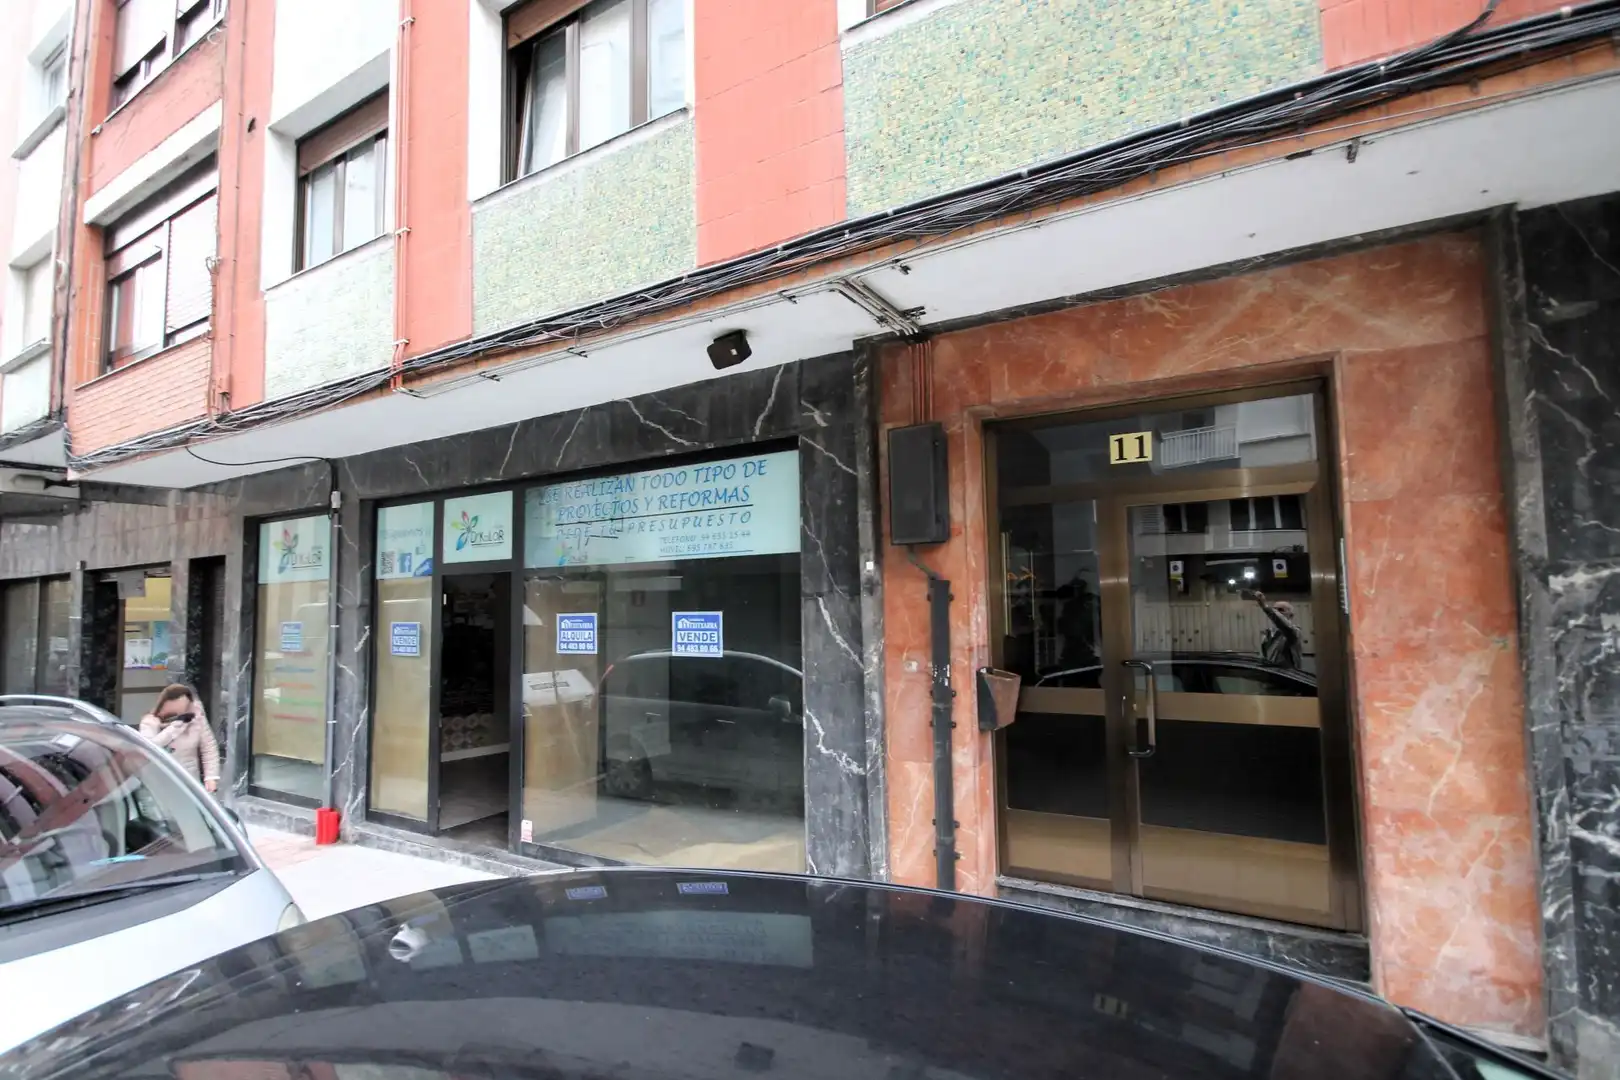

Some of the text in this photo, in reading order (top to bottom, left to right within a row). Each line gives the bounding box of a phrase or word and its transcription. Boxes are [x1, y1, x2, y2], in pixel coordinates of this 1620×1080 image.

[1113, 434, 1149, 461] 11
[564, 476, 636, 500] REALIZAN
[641, 470, 688, 490] TODO
[693, 463, 737, 484] TIPO
[742, 459, 768, 478] DE
[557, 484, 751, 520] PROYECTOS Y REFORMAS
[627, 511, 752, 534] PRESUPUESTO
[561, 631, 593, 641] ALQUILA
[679, 632, 717, 642] VENDE
